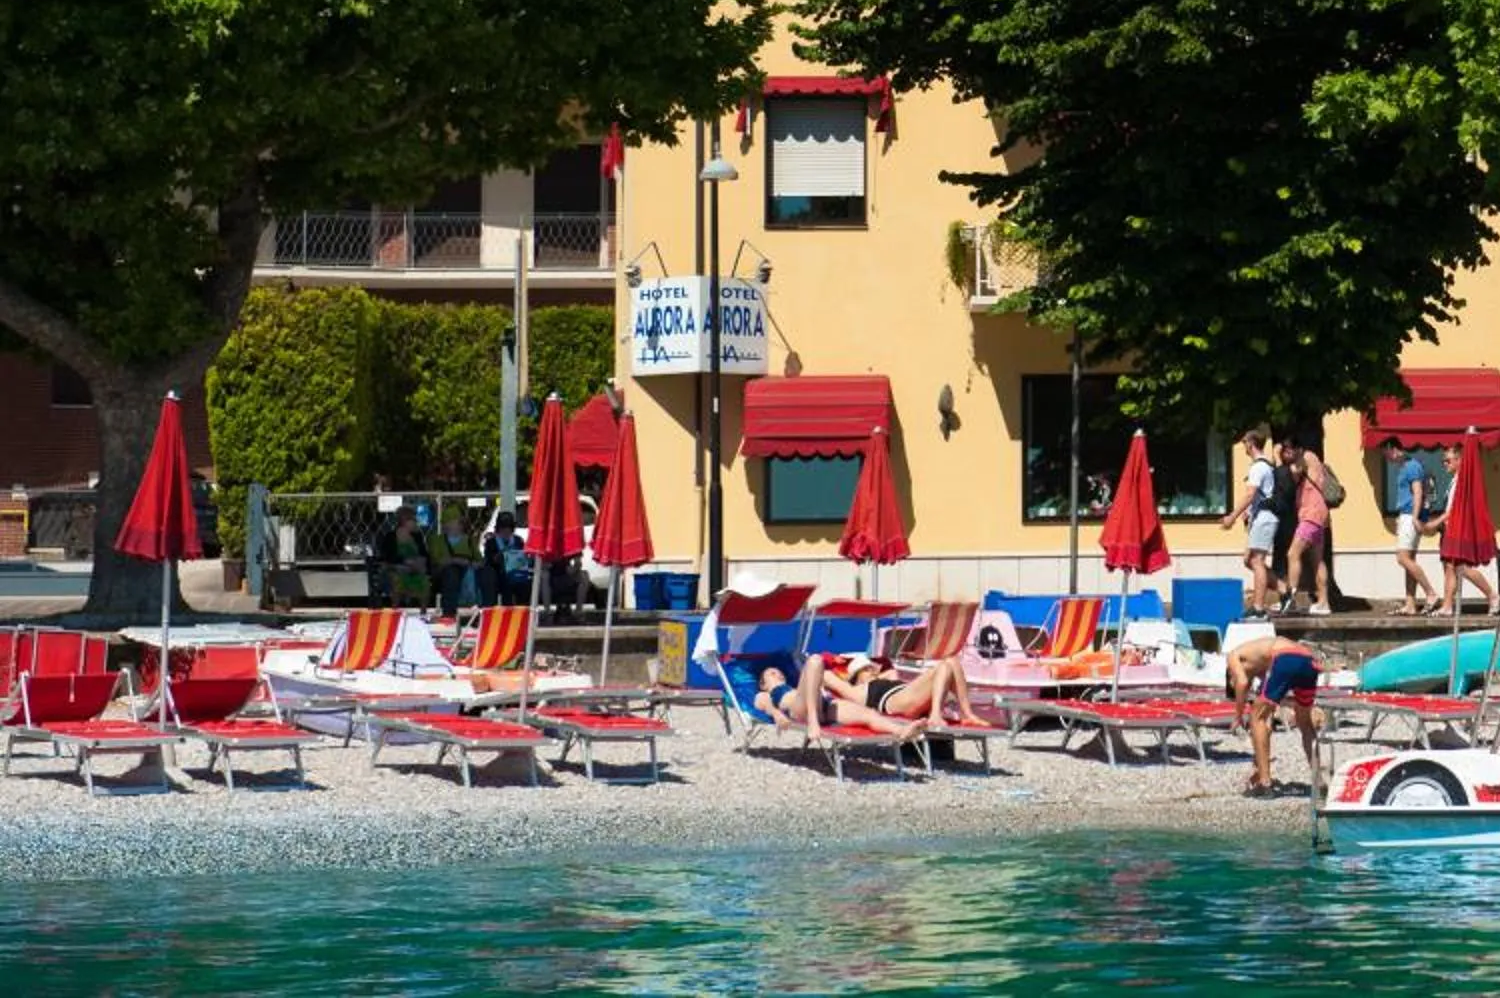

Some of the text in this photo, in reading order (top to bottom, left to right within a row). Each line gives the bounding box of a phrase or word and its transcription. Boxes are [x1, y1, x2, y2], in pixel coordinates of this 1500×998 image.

[639, 287, 688, 301] HOTEL
[719, 287, 760, 301] OTEL
[635, 305, 695, 339] AURORA
